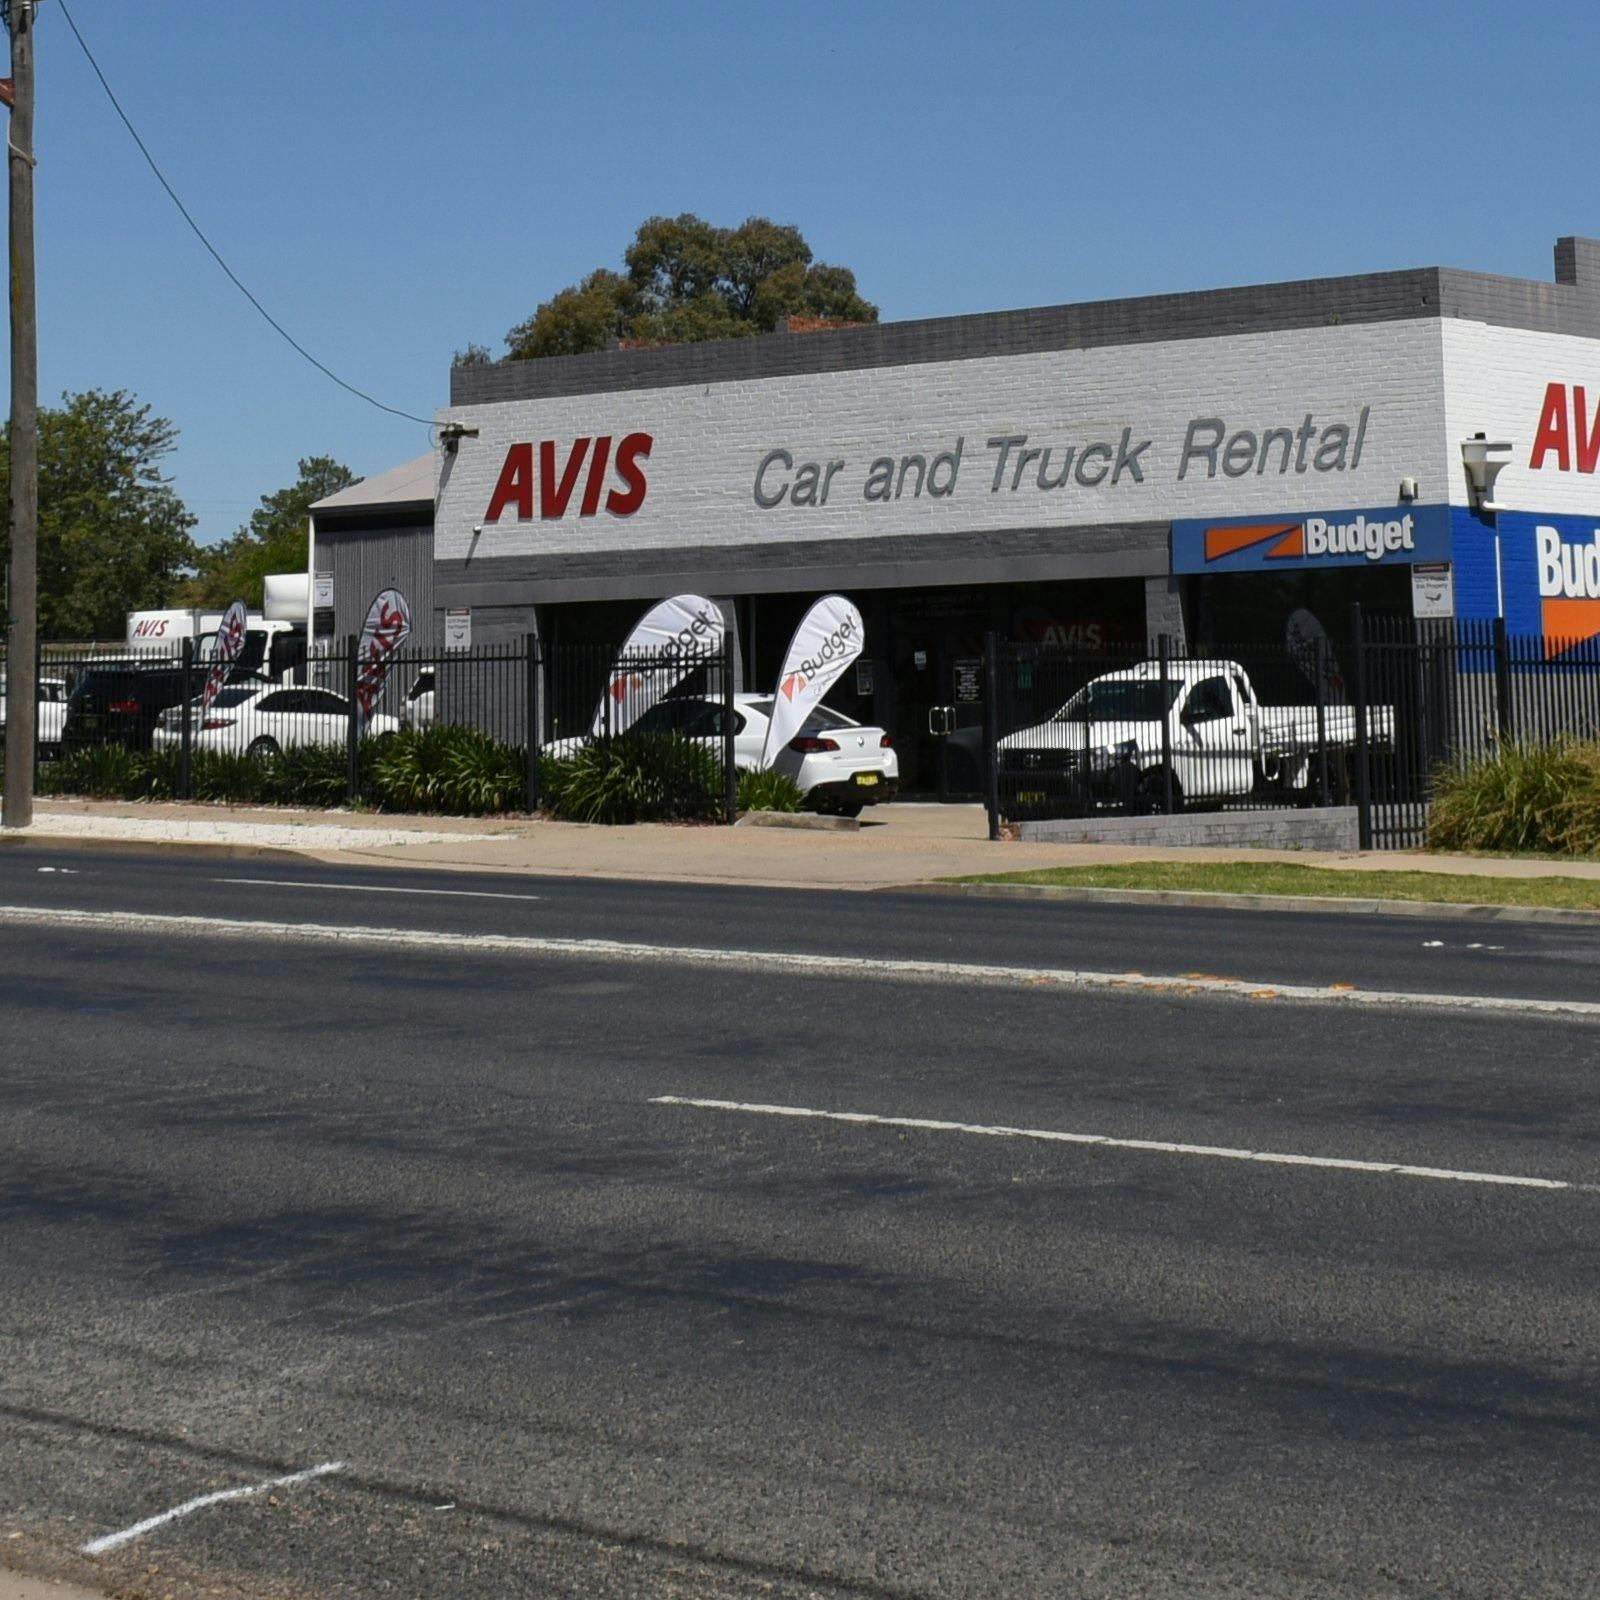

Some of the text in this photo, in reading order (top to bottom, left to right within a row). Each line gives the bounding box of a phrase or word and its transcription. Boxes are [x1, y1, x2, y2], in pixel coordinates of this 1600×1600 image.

[485, 406, 1370, 521] AVIS Car and Truck Rental
[1306, 514, 1414, 560] Budget
[133, 620, 169, 637] AVIS
[800, 614, 857, 681] Budget
[1042, 623, 1102, 648] AVIS
